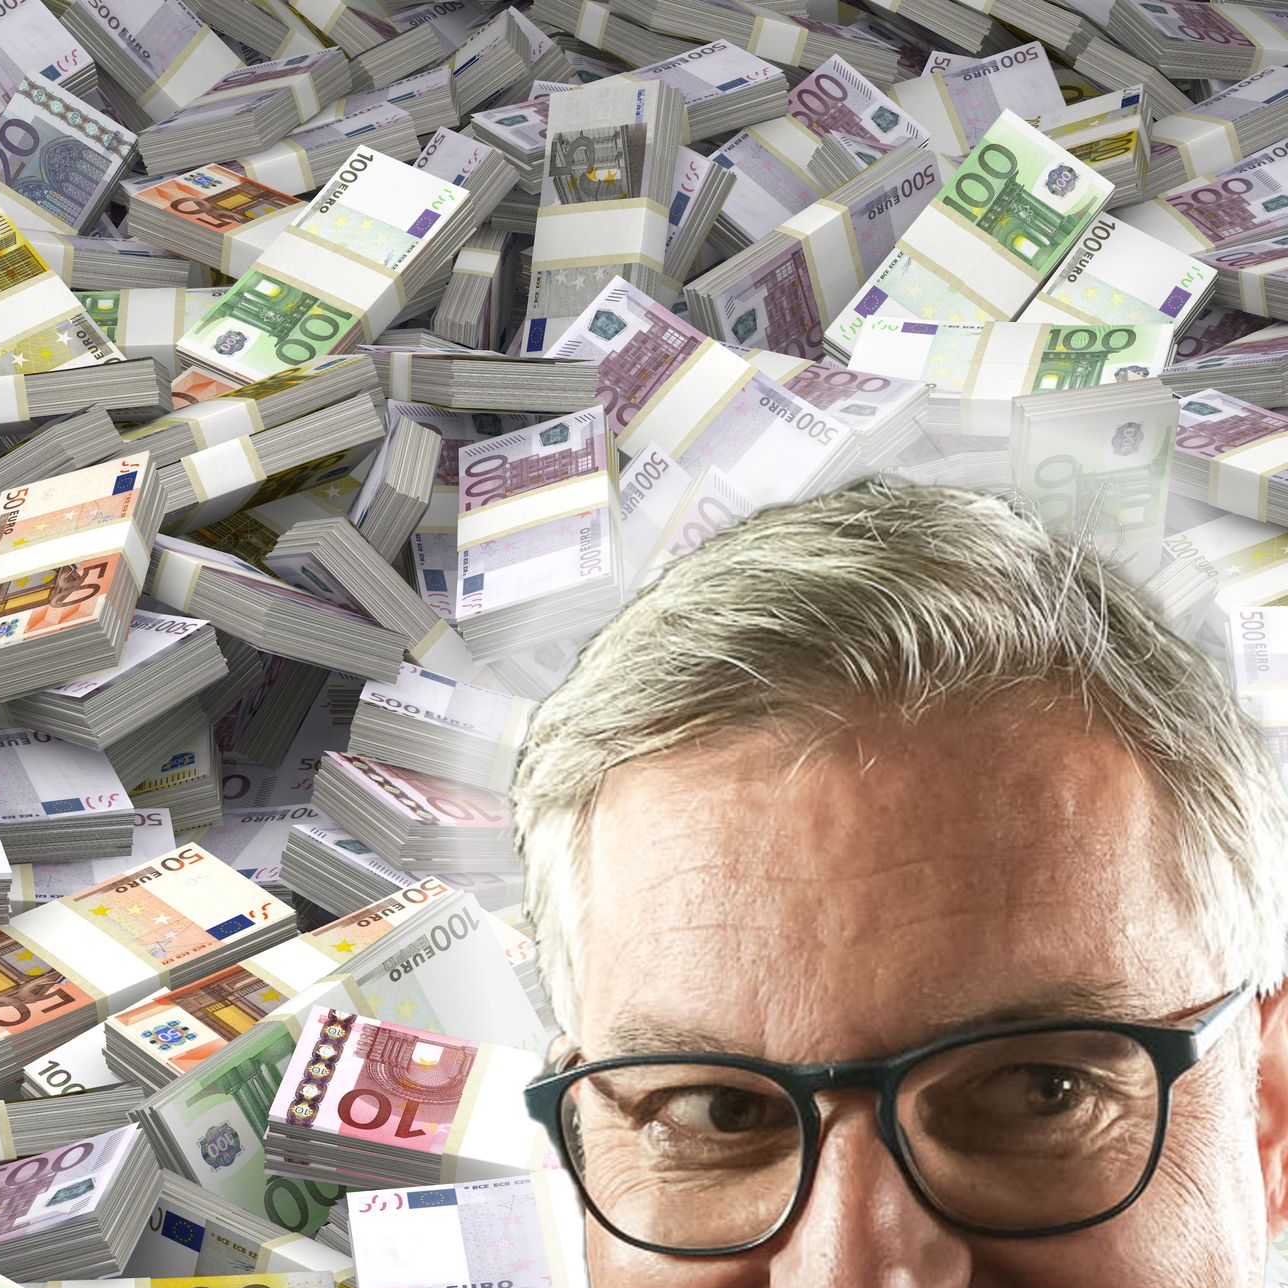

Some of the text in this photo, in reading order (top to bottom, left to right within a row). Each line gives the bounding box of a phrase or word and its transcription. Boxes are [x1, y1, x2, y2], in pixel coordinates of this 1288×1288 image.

[318, 153, 372, 215] 100 EURO
[941, 143, 1019, 217] 100
[1068, 222, 1117, 282] 100 EURO
[275, 299, 352, 365] 100
[1047, 327, 1137, 353] 100
[3, 488, 29, 535] 50 EURO
[51, 560, 109, 609] 50
[115, 849, 205, 895] 50 EURO
[356, 877, 450, 928] 50 EURO
[337, 1089, 427, 1138] 10
